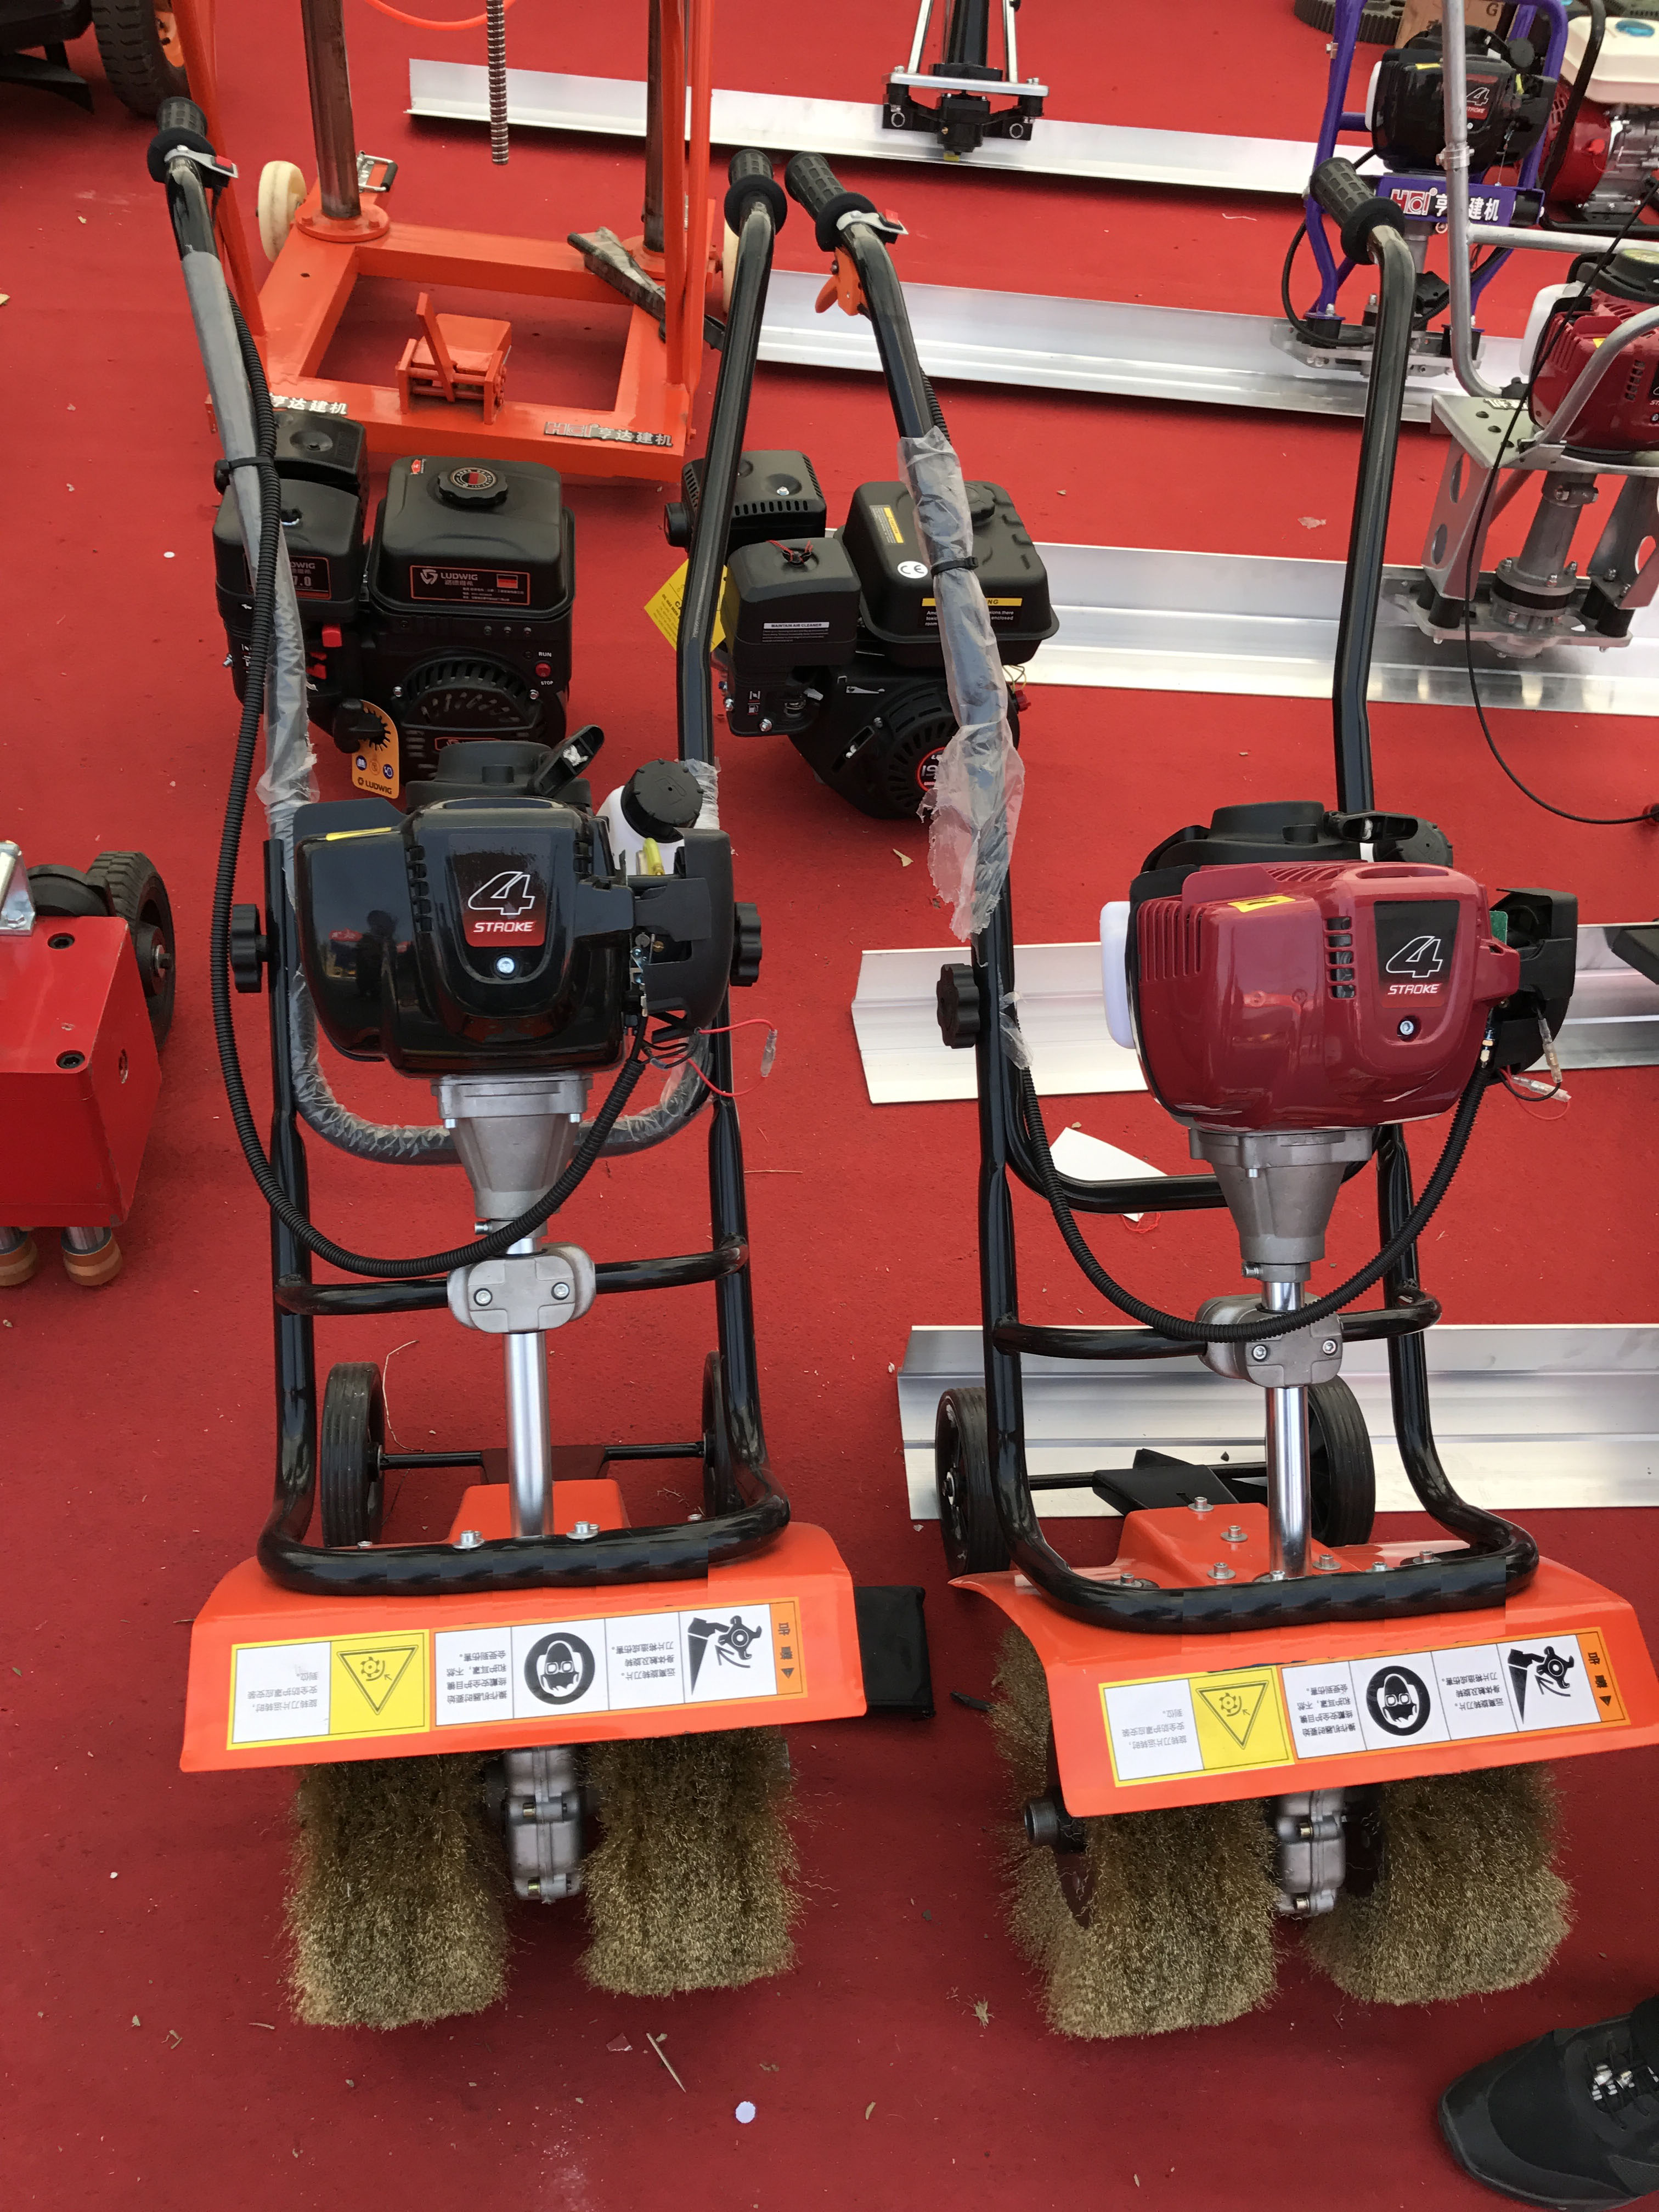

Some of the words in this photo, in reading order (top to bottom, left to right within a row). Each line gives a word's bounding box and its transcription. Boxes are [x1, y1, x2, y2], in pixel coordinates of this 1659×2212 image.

[1435, 194, 1500, 221] 亨建机
[598, 427, 673, 446] 亨达建机
[441, 572, 478, 580] LUDWIG
[900, 565, 924, 574] CE
[365, 780, 392, 795] LUDWIG
[467, 871, 535, 916] 4
[473, 921, 534, 933] STROKE
[1386, 935, 1443, 978] 4
[1387, 984, 1440, 995] STROKE
[624, 1654, 674, 1667] 身体触及旋转
[447, 1677, 506, 1691] 终戴安全护目镜
[247, 1685, 318, 1700] 安全防护罩应安装
[447, 1690, 507, 1705] 操作机器时要始
[1455, 1685, 1500, 1699] 身体触及旋转
[1299, 1710, 1353, 1724] 终戴安全护目镜
[1121, 1722, 1185, 1737] 安全防护罩应安装
[1302, 1723, 1356, 1737] 操作机器时要始
